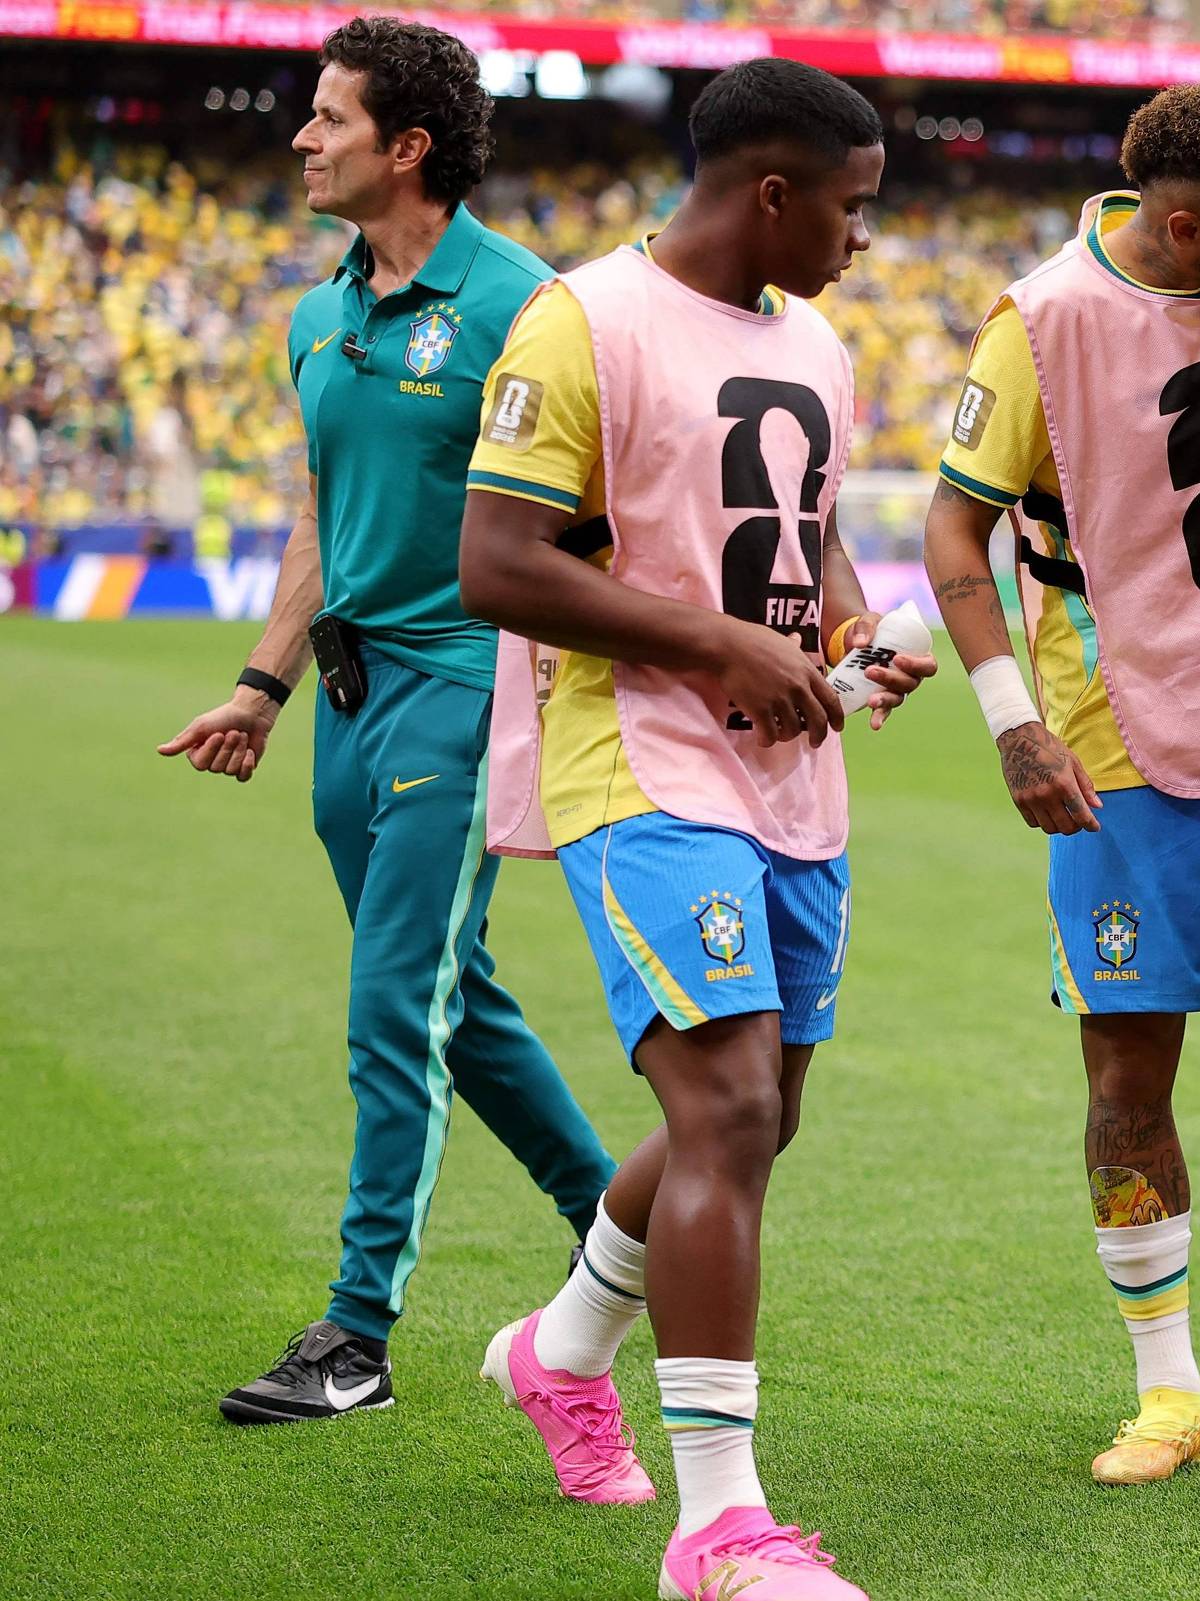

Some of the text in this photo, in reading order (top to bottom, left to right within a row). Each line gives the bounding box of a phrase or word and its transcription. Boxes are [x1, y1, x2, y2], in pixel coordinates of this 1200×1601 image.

[422, 340, 440, 348] CBF
[399, 380, 444, 398] BRASIL
[765, 598, 819, 627] FIFA
[714, 924, 732, 935] CBF
[829, 886, 849, 974] 1
[1108, 934, 1125, 942] CBF
[705, 964, 755, 983] BRASIL
[1093, 969, 1141, 981] BRASIL
